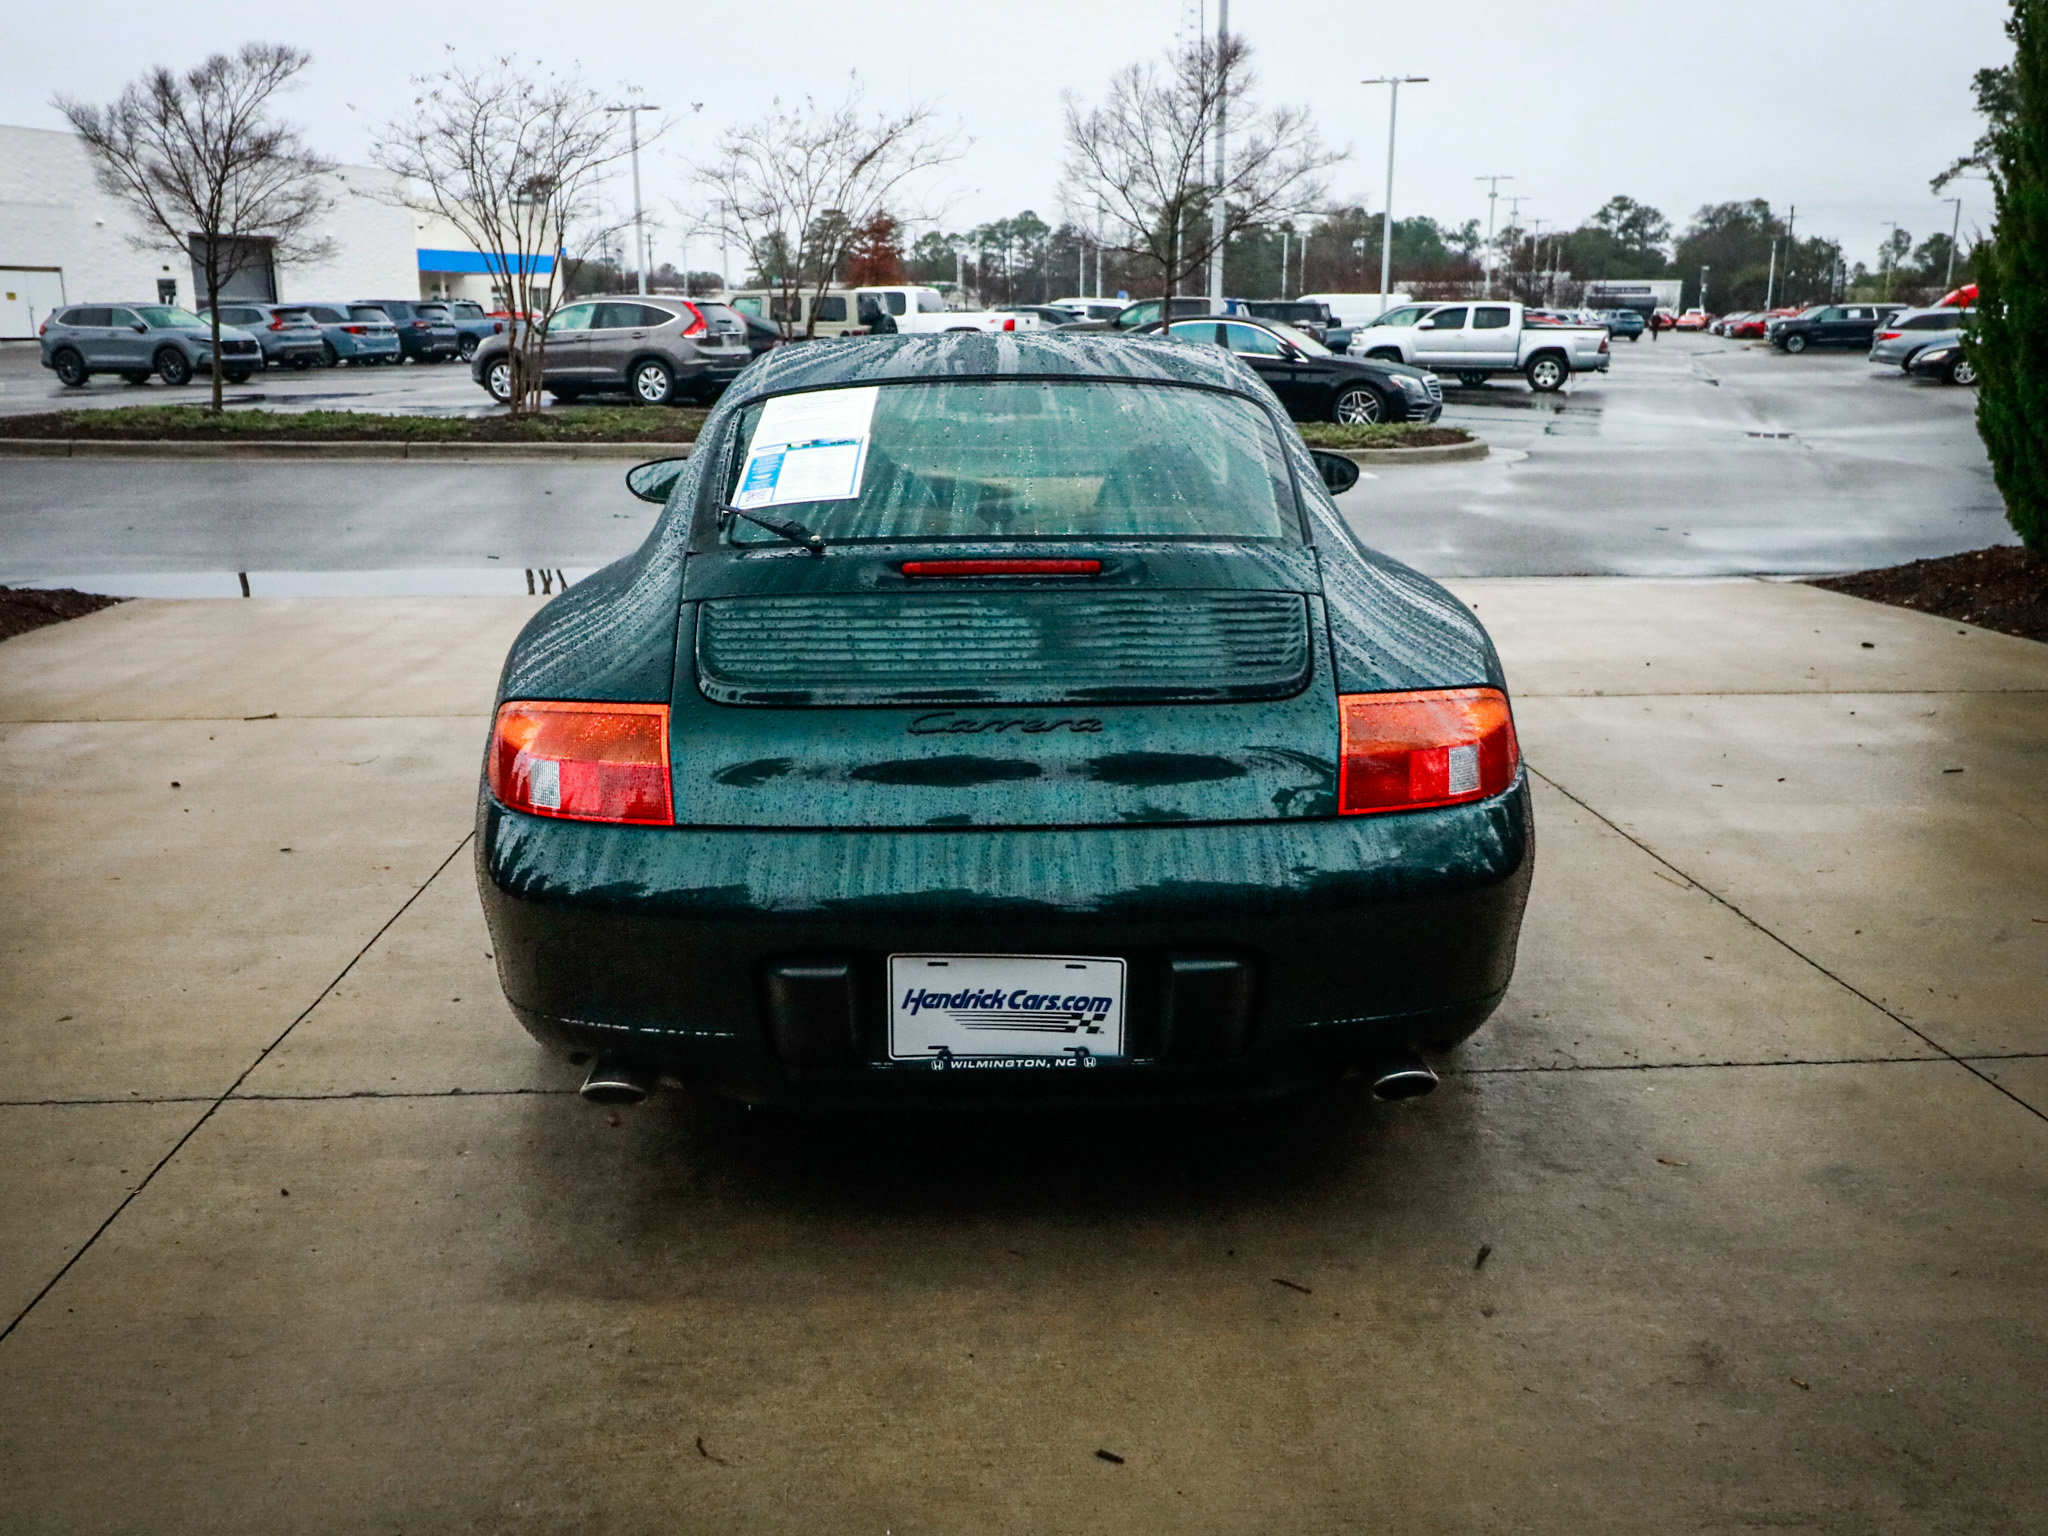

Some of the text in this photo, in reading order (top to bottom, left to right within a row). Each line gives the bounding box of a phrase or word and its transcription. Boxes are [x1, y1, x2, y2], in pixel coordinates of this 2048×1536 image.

[907, 711, 1103, 735] Carrera
[901, 988, 1113, 1016] HendrickCars.com
[950, 1058, 1077, 1070] WILMINGTON, NC
